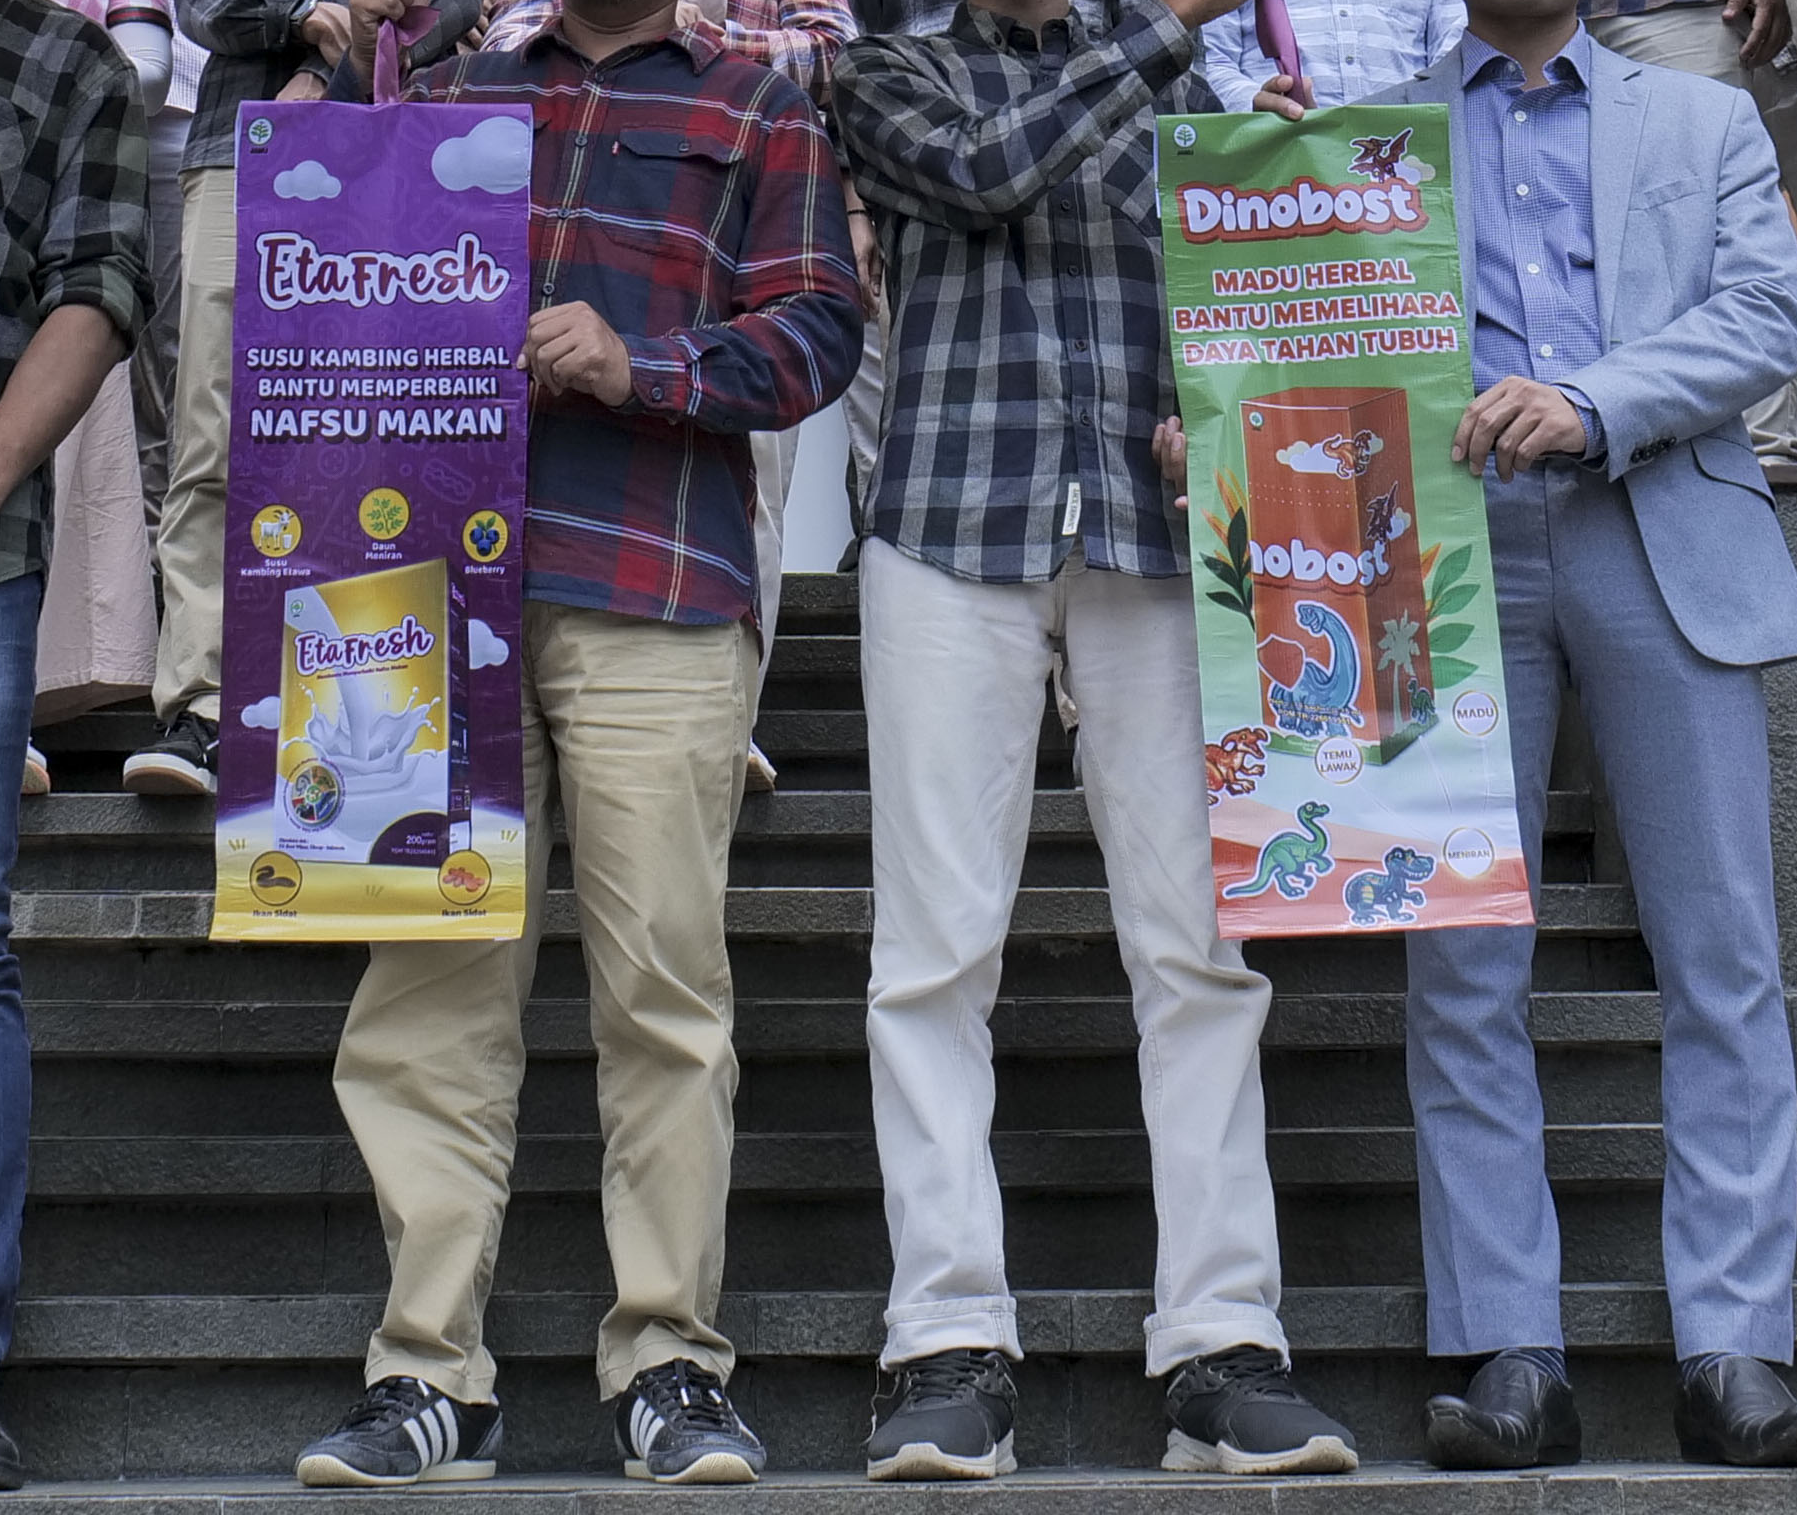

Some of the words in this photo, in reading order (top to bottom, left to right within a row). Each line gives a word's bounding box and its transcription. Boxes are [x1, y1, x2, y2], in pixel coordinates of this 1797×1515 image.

[1183, 183, 1419, 234] Dinobost
[261, 237, 505, 302] EtaFresh
[1214, 267, 1300, 294] MADU
[1305, 260, 1413, 289] HERBAL
[1174, 304, 1267, 331] BANTU
[1274, 294, 1460, 326] MEMELIHARA
[1183, 341, 1258, 365] DAYA
[1261, 333, 1356, 361] TAHAN
[1361, 328, 1456, 353] TUBUH
[246, 348, 304, 367] SUSU
[310, 348, 419, 367] KAMBING
[424, 347, 510, 366] HERBAL
[258, 378, 334, 397] BANTU
[341, 377, 497, 397] MEMPERBAIKI
[251, 409, 368, 437] NAFSU
[378, 407, 503, 436] MAKAN
[365, 551, 403, 560] Meniran
[372, 542, 396, 551] Daun
[240, 567, 282, 578] Kambing
[264, 558, 288, 567] Susu
[464, 565, 506, 575] Blueberry
[297, 619, 431, 671] EtaFresh
[1457, 709, 1494, 720] MADU
[1323, 750, 1352, 760] TEMU
[1320, 762, 1357, 773] LAWAK
